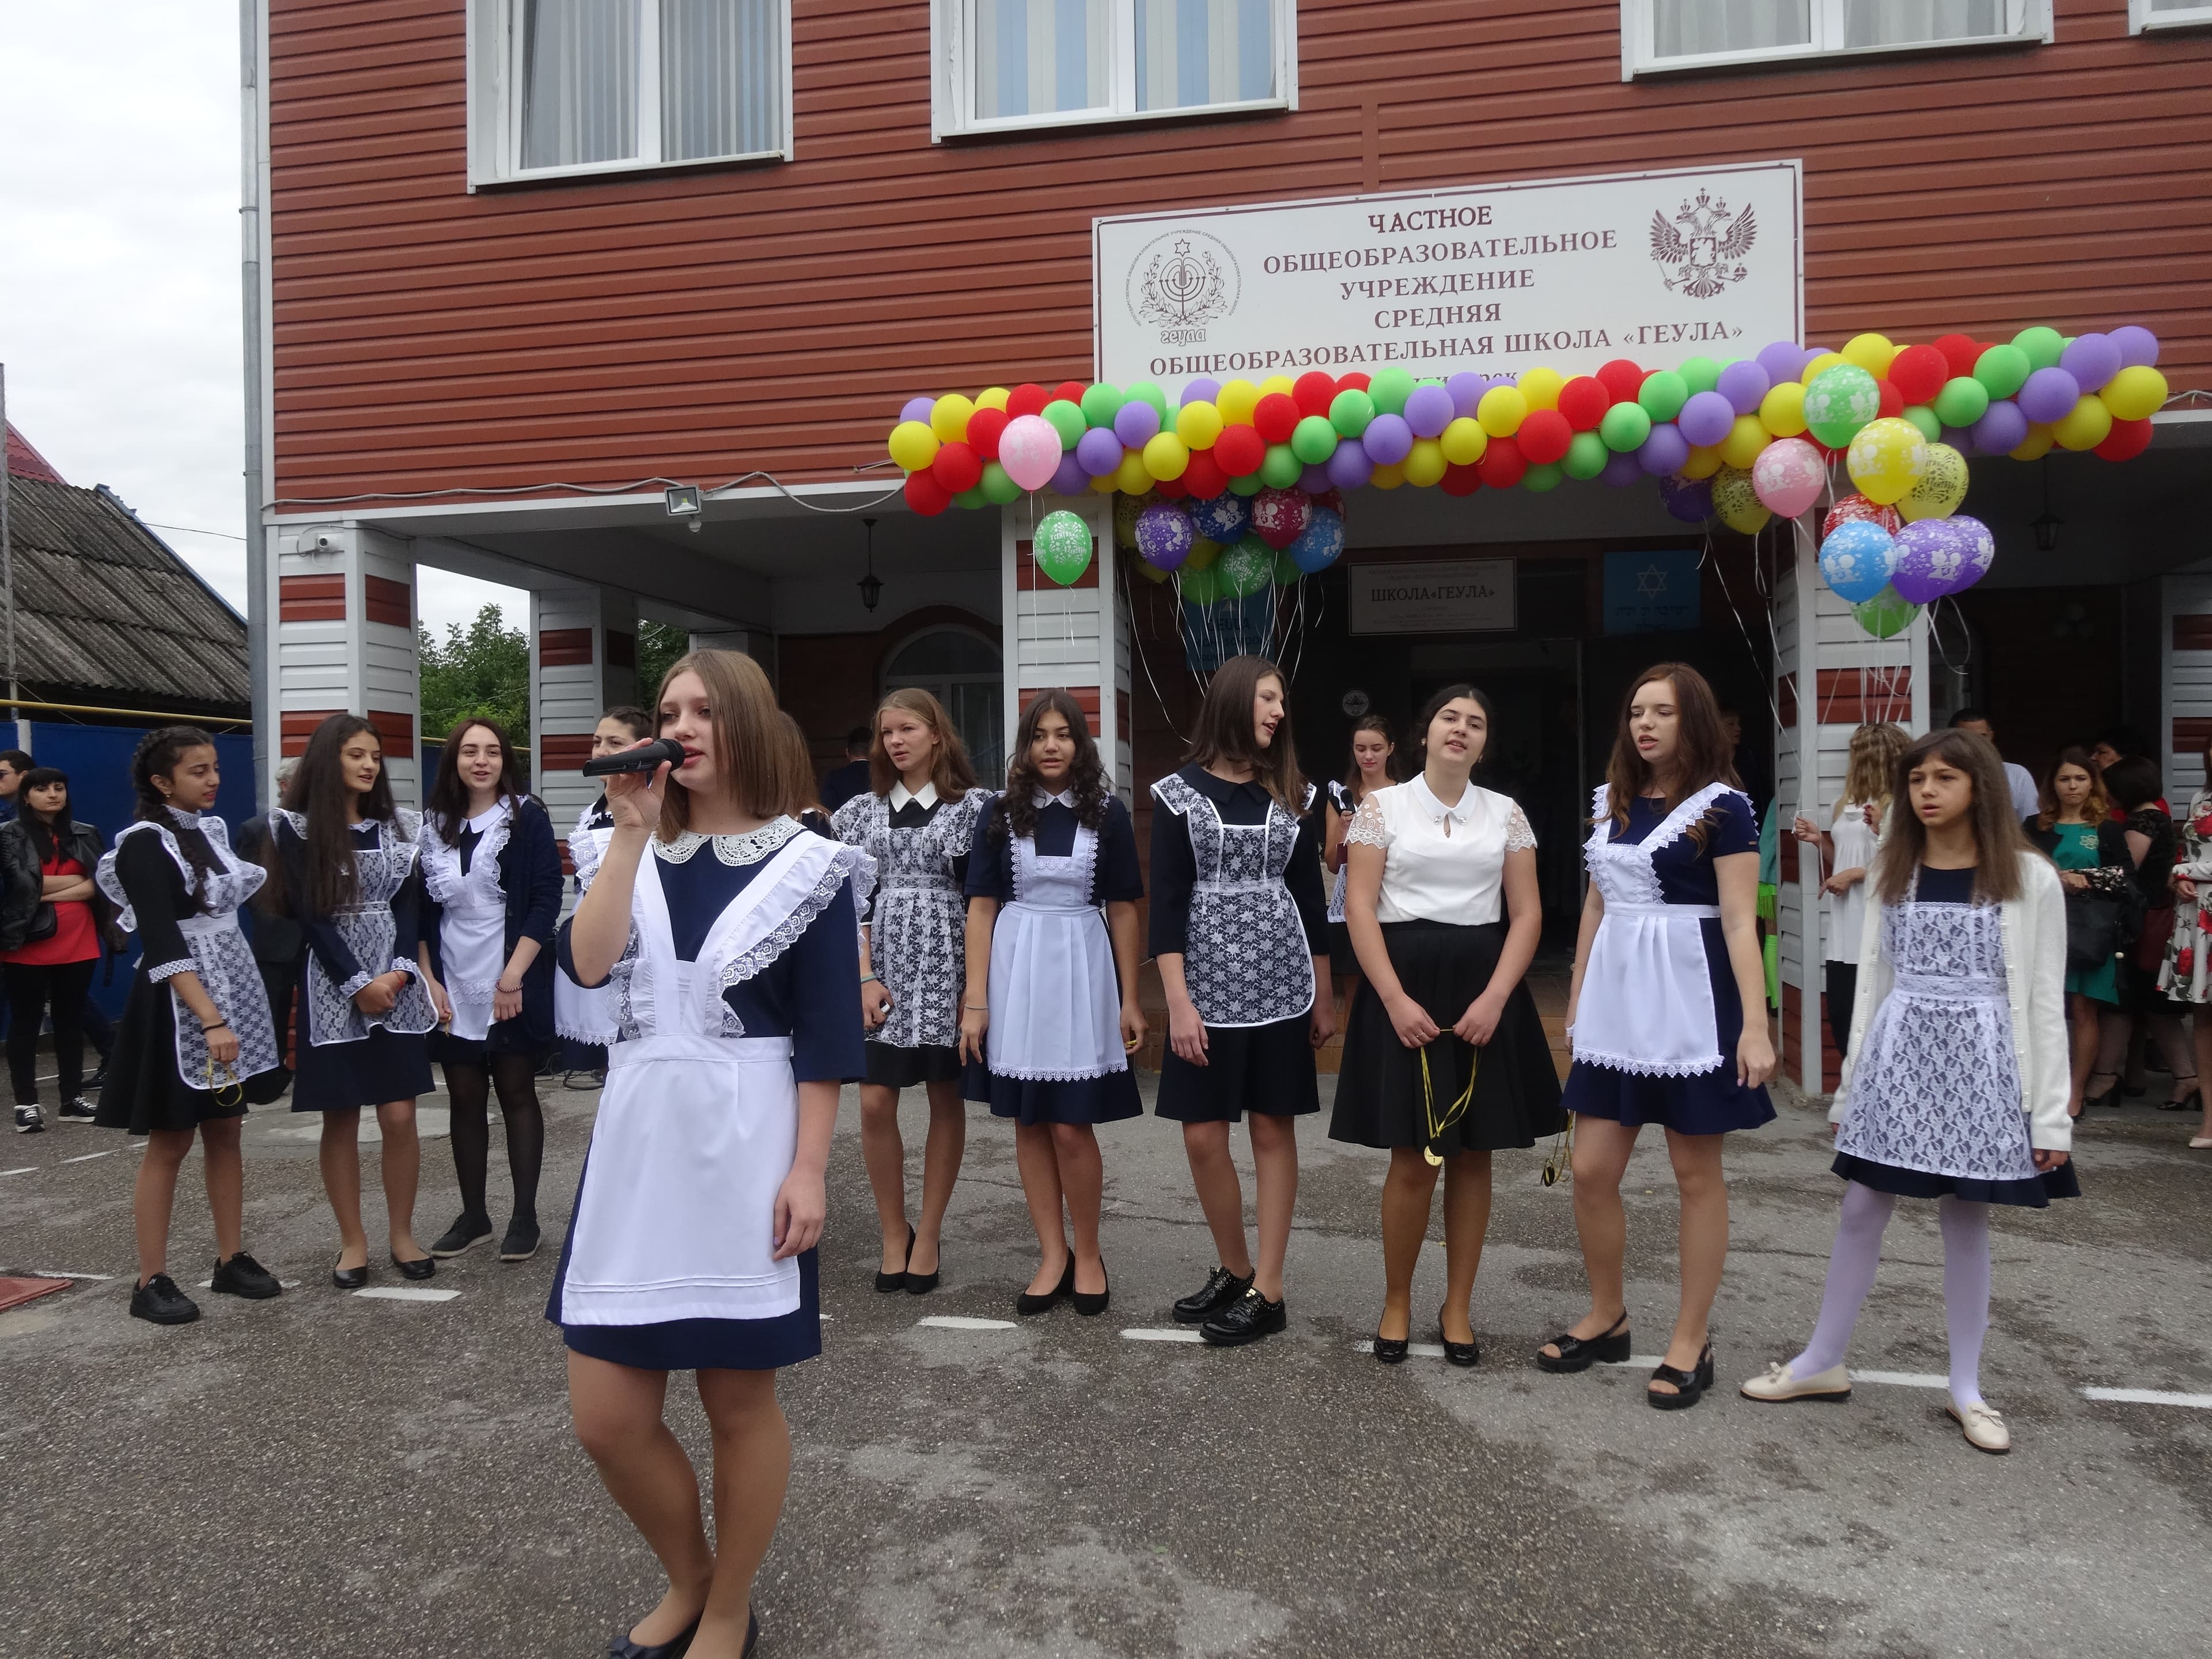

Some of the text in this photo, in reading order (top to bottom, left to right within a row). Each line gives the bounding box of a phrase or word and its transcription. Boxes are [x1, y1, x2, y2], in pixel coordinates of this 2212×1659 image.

[1368, 205, 1493, 234] ЧАСТНОЕ
[1263, 230, 1618, 274] ОБЩЕОБРАЗОВАТЕЛЬНОЕ
[1340, 269, 1535, 301] УЧРЕЖДЕНИЕ
[1374, 303, 1502, 329] СРЕДНЯЯ
[1150, 321, 1743, 376] ОБЩЕОБРАЗОВАТЕЛЬНАЯ ШКОЛА «ГЕУЛА»
